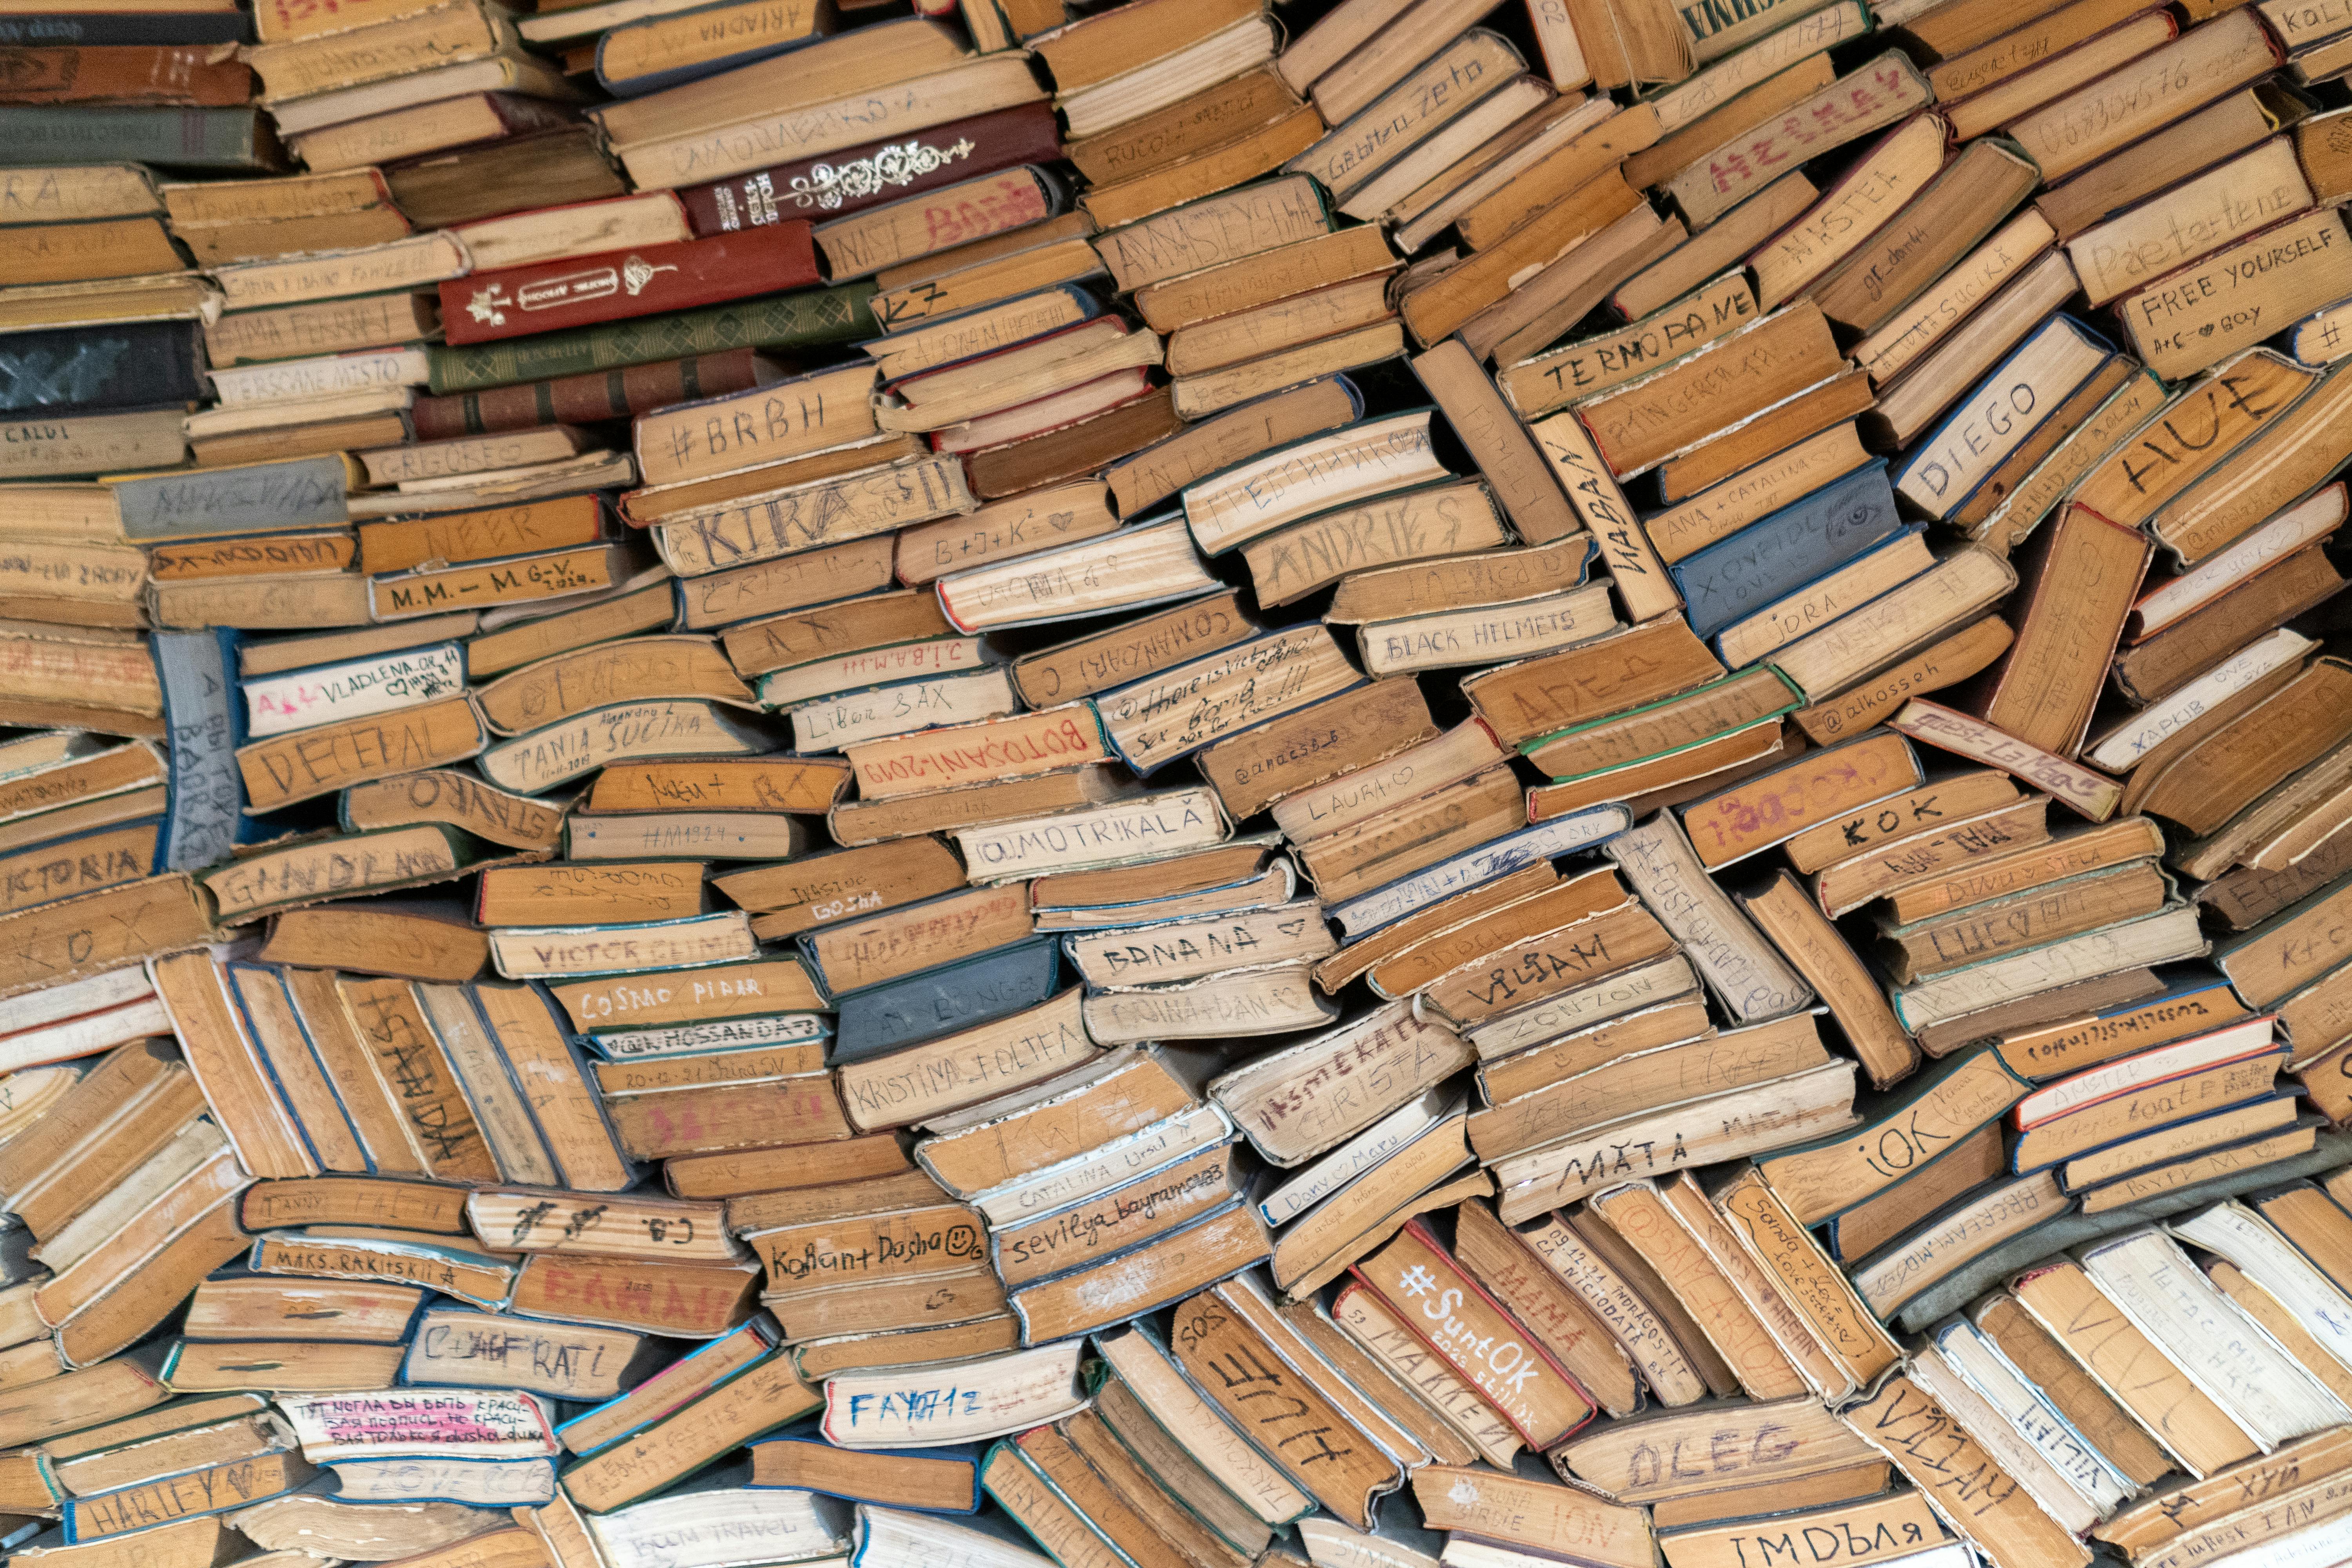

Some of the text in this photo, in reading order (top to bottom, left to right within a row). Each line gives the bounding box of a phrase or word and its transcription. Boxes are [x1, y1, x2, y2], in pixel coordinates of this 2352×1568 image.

[2140, 227, 2334, 327] FREE YOURSELF
[1915, 380, 2038, 500] DIEGO
[1386, 607, 1577, 663] BLACK HELMETS
